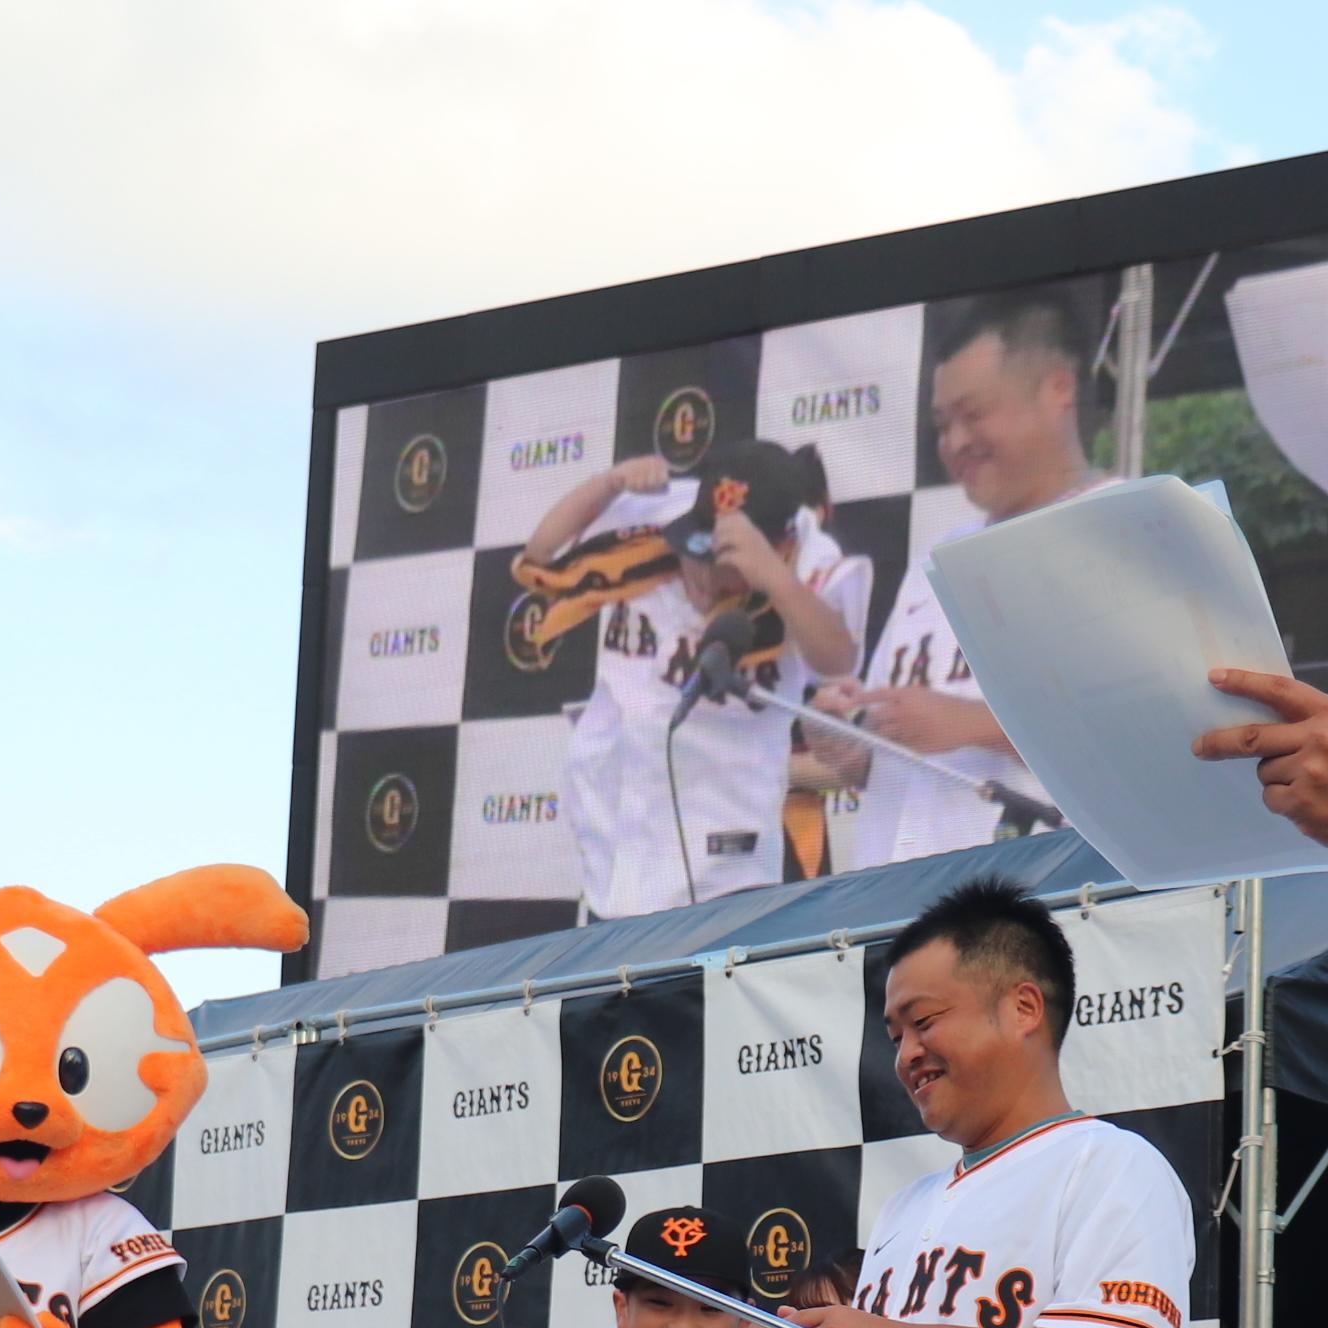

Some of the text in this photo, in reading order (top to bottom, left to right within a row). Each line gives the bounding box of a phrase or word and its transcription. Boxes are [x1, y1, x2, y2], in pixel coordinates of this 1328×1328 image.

[791, 385, 881, 426] GIANTS
[510, 432, 585, 470] GIANTS
[369, 625, 440, 658] GIANTS
[482, 790, 559, 825] GIANTS
[1075, 981, 1185, 1028] GIANTS
[737, 1033, 824, 1075] GIANTS
[453, 1081, 530, 1119] GIANTS
[200, 1120, 266, 1155] GIANTS
[307, 1279, 384, 1312] GIANTS
